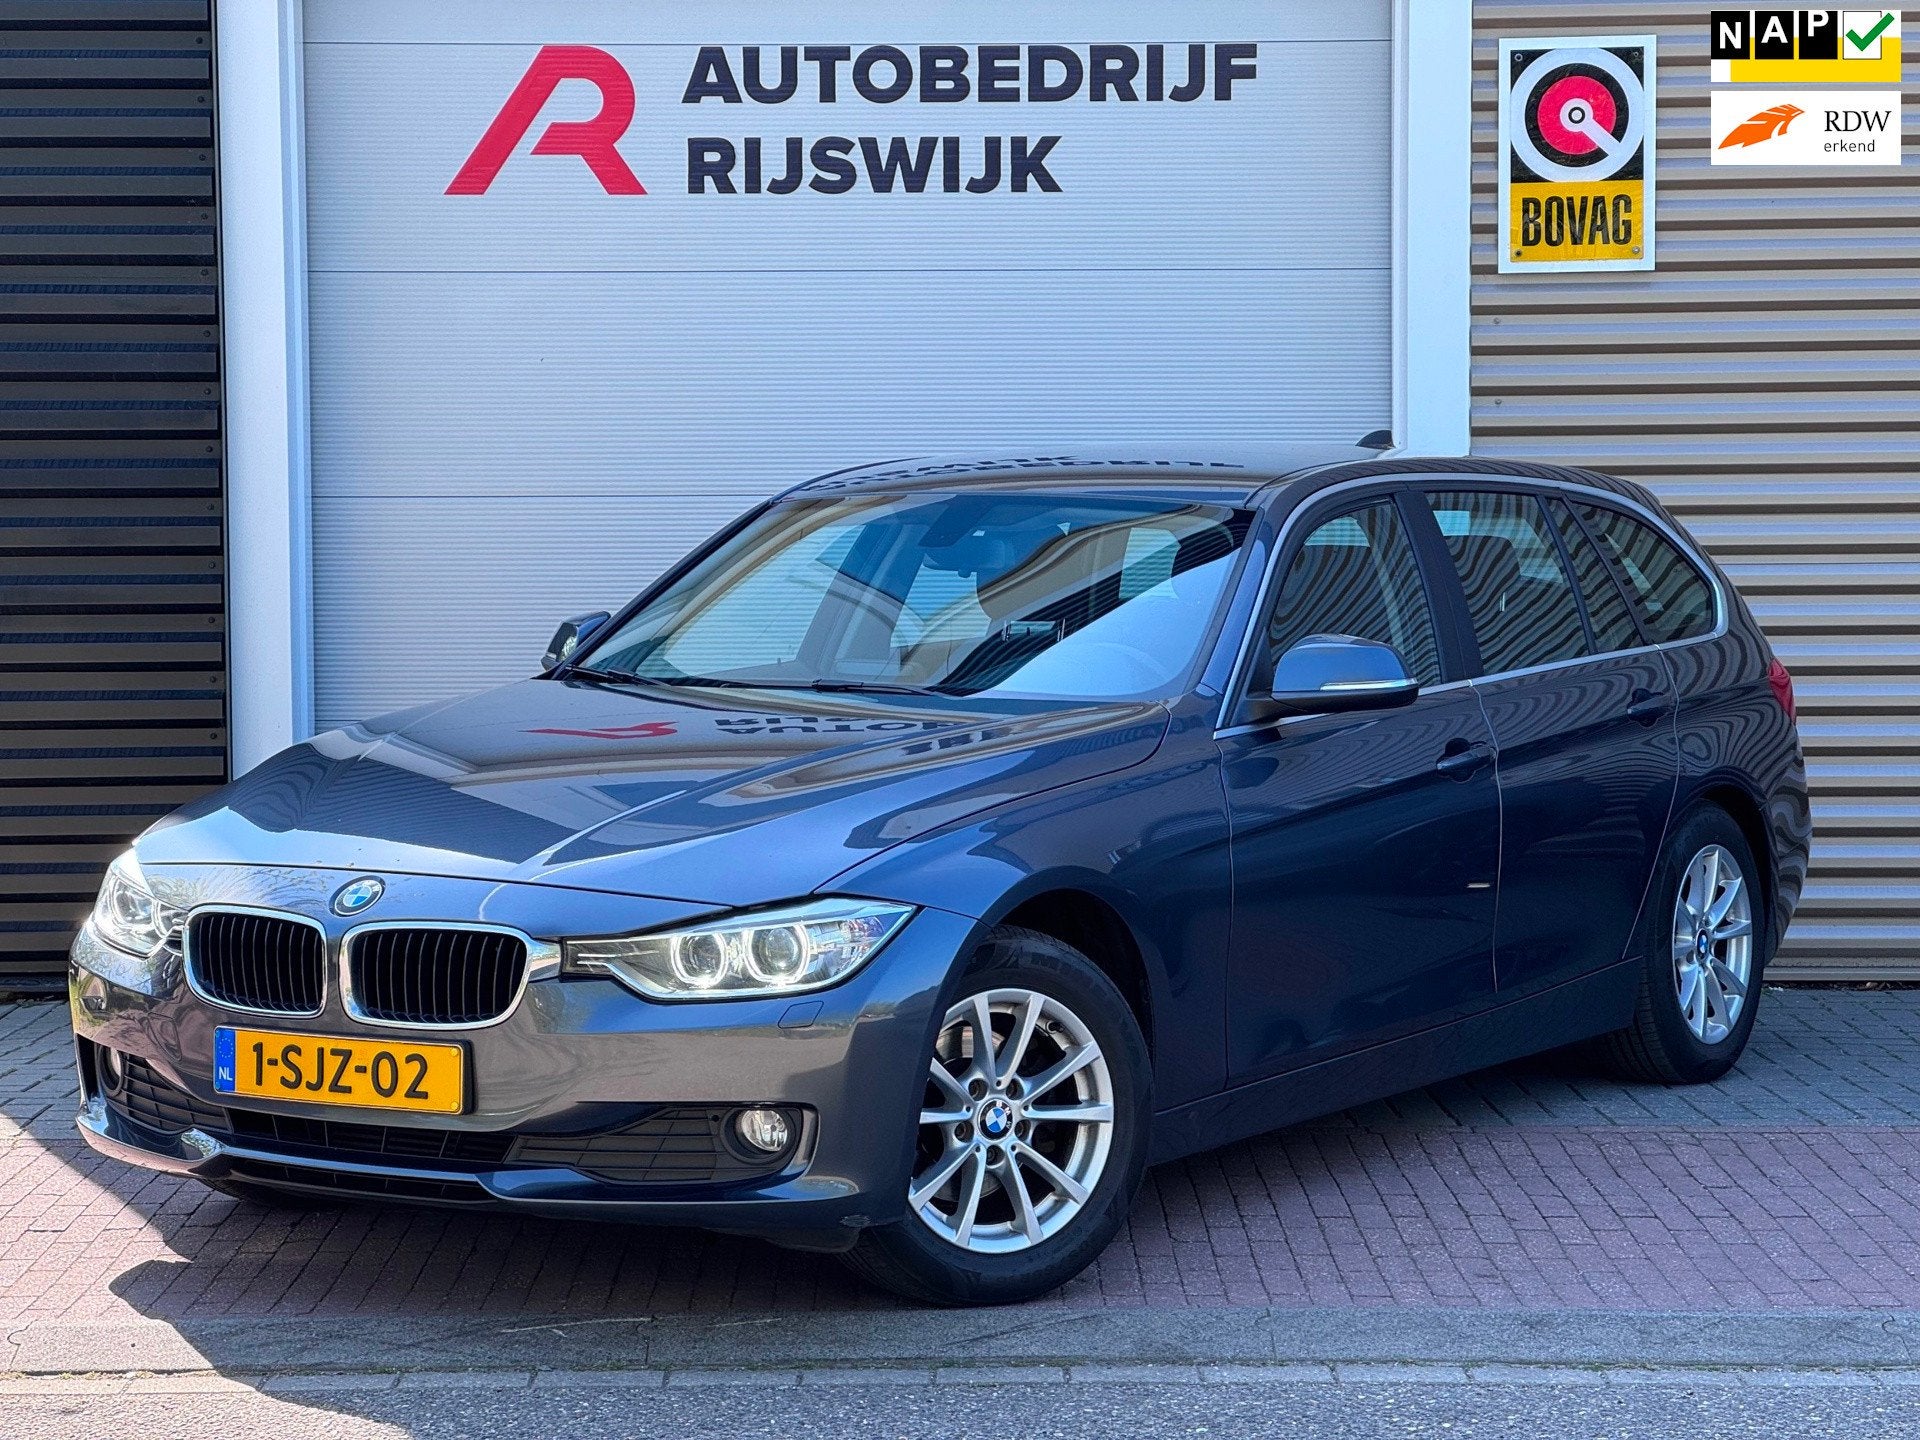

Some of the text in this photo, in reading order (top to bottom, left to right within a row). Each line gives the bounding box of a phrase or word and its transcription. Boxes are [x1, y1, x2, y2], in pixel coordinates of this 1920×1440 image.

[681, 43, 1258, 105] AUTOBEDRIJF
[687, 135, 1064, 195] RIJSWIJK
[1521, 194, 1632, 247] BOVAG
[218, 1066, 233, 1081] NL
[252, 1041, 429, 1100] 1-SJZ-02
